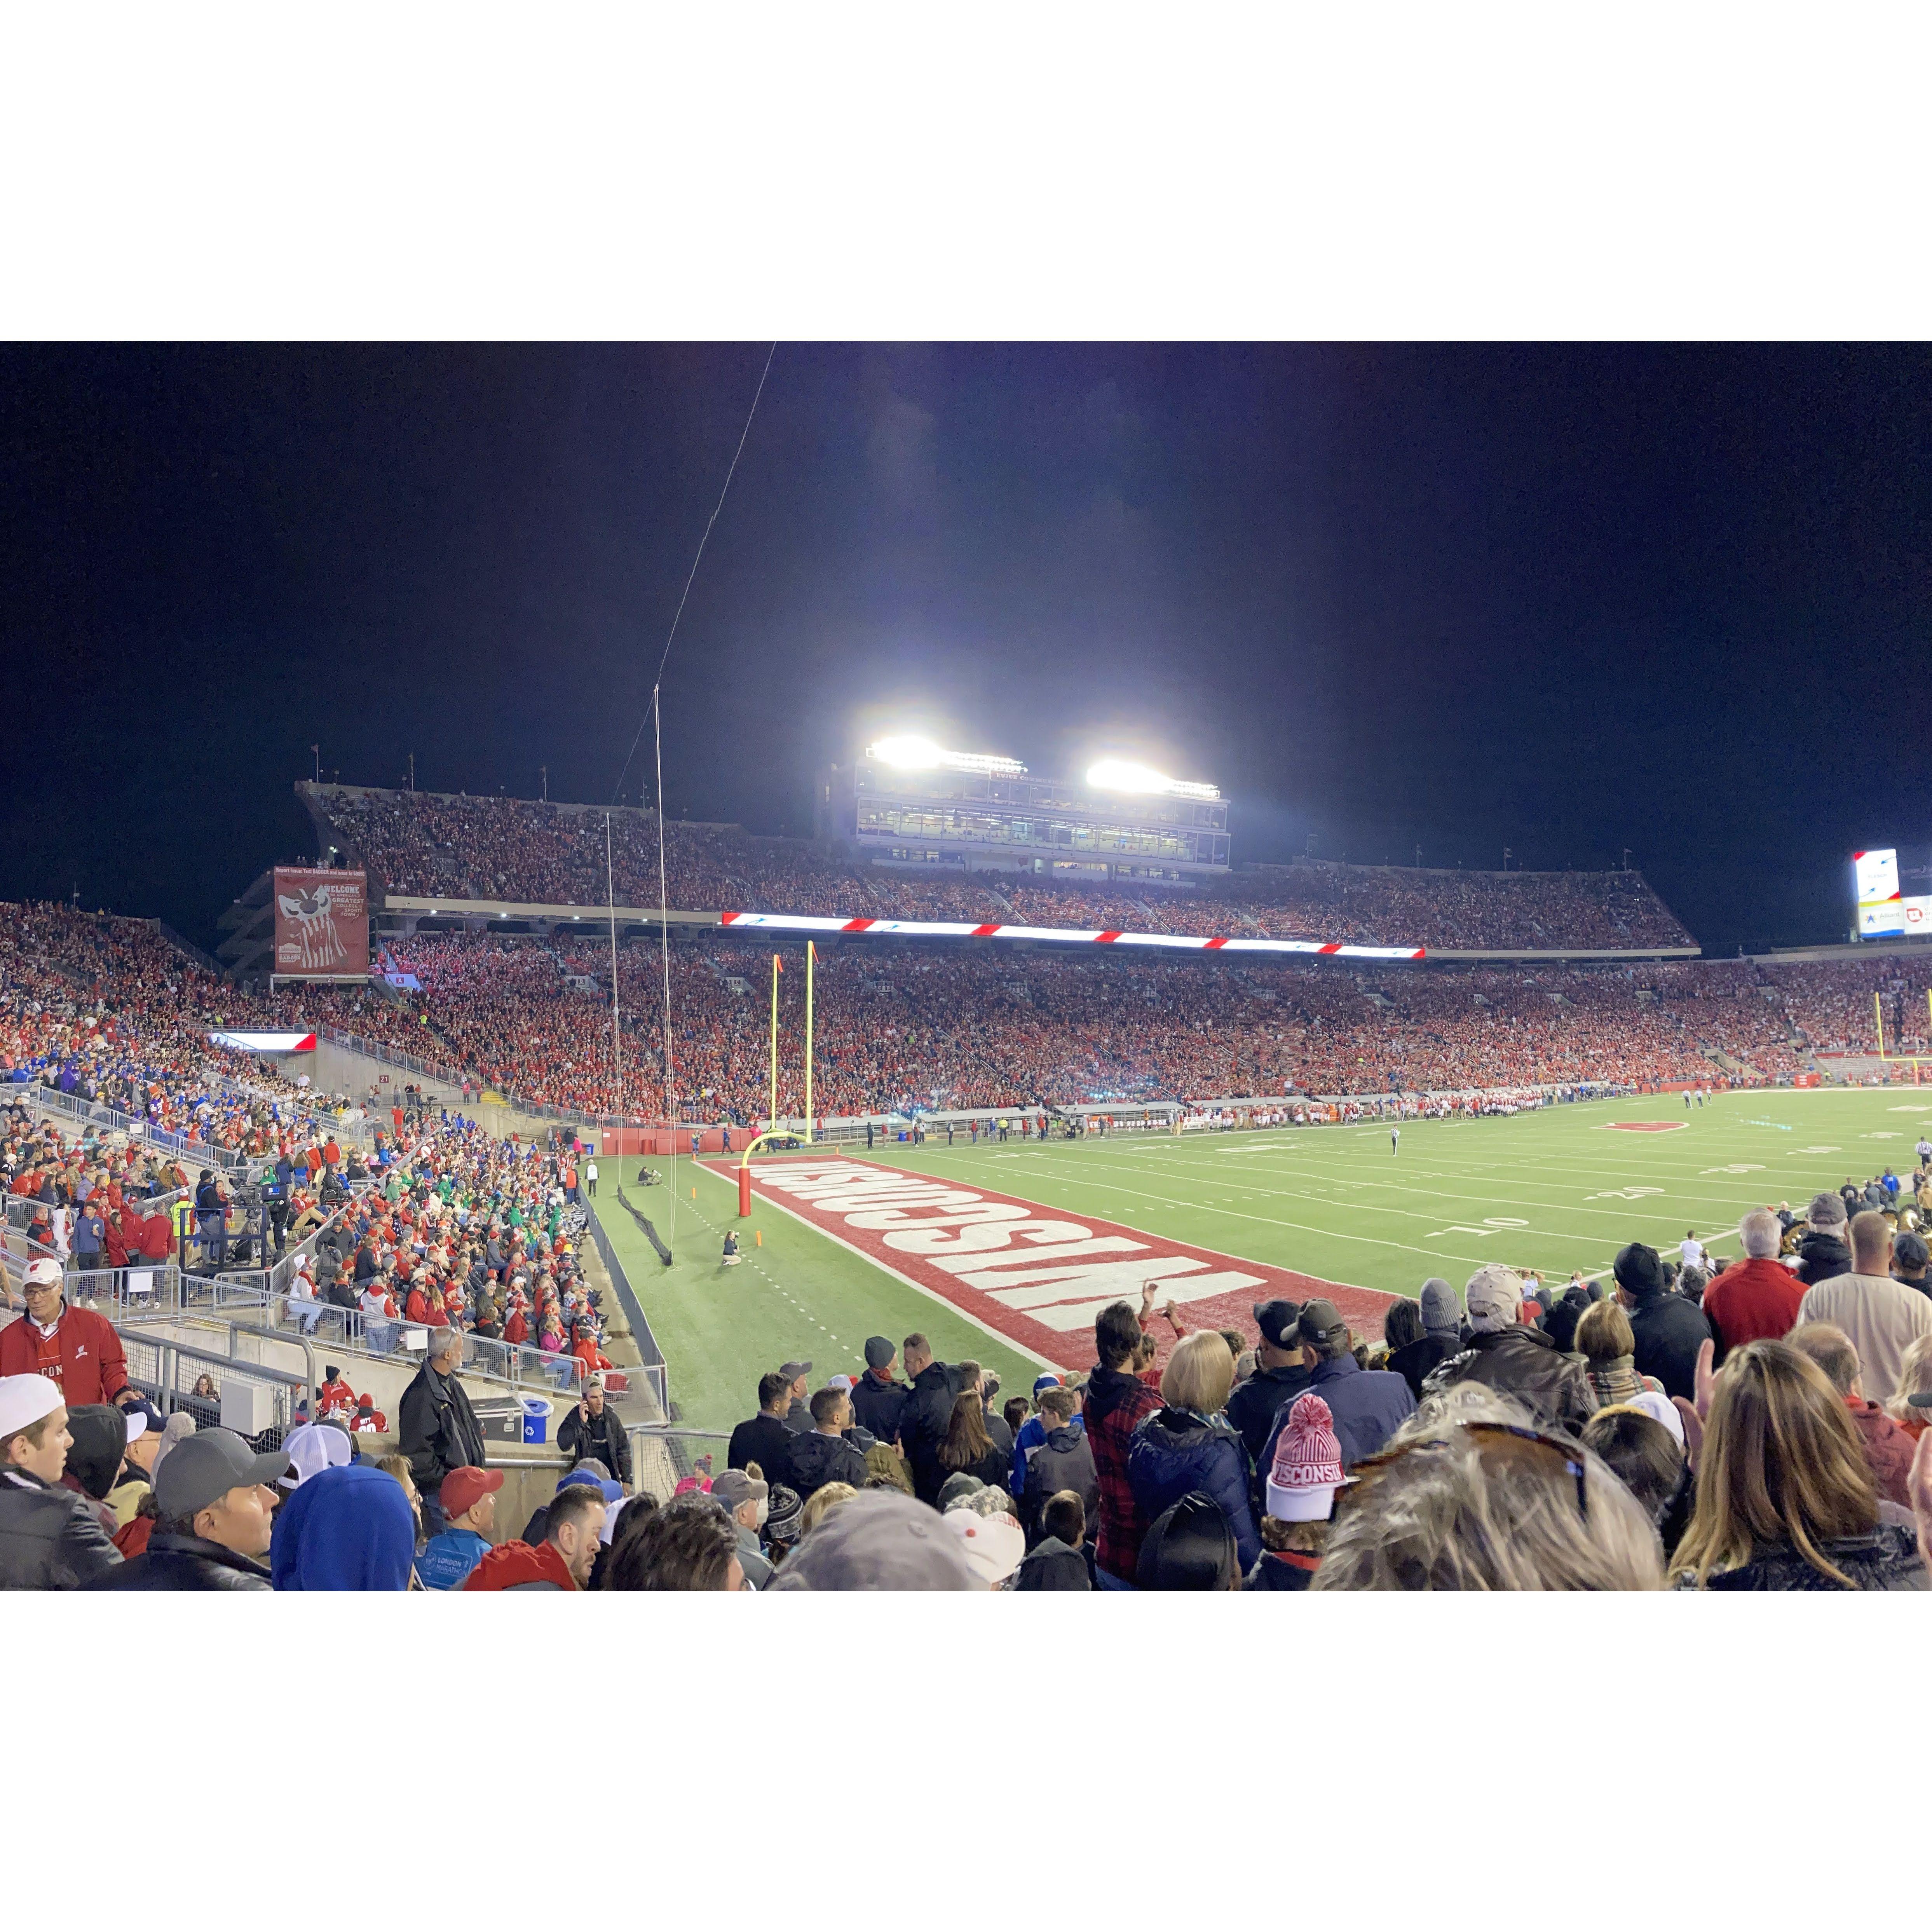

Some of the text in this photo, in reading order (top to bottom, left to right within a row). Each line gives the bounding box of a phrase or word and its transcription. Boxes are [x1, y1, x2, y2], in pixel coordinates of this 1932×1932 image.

[324, 885, 359, 893] WELCOME
[1707, 1164, 1766, 1173] 30
[1597, 1186, 1666, 1200] 20
[1442, 1217, 1529, 1236] 10
[37, 1364, 63, 1378] CON
[438, 1557, 462, 1567] LONDON
[437, 1564, 467, 1577] MARATHON
